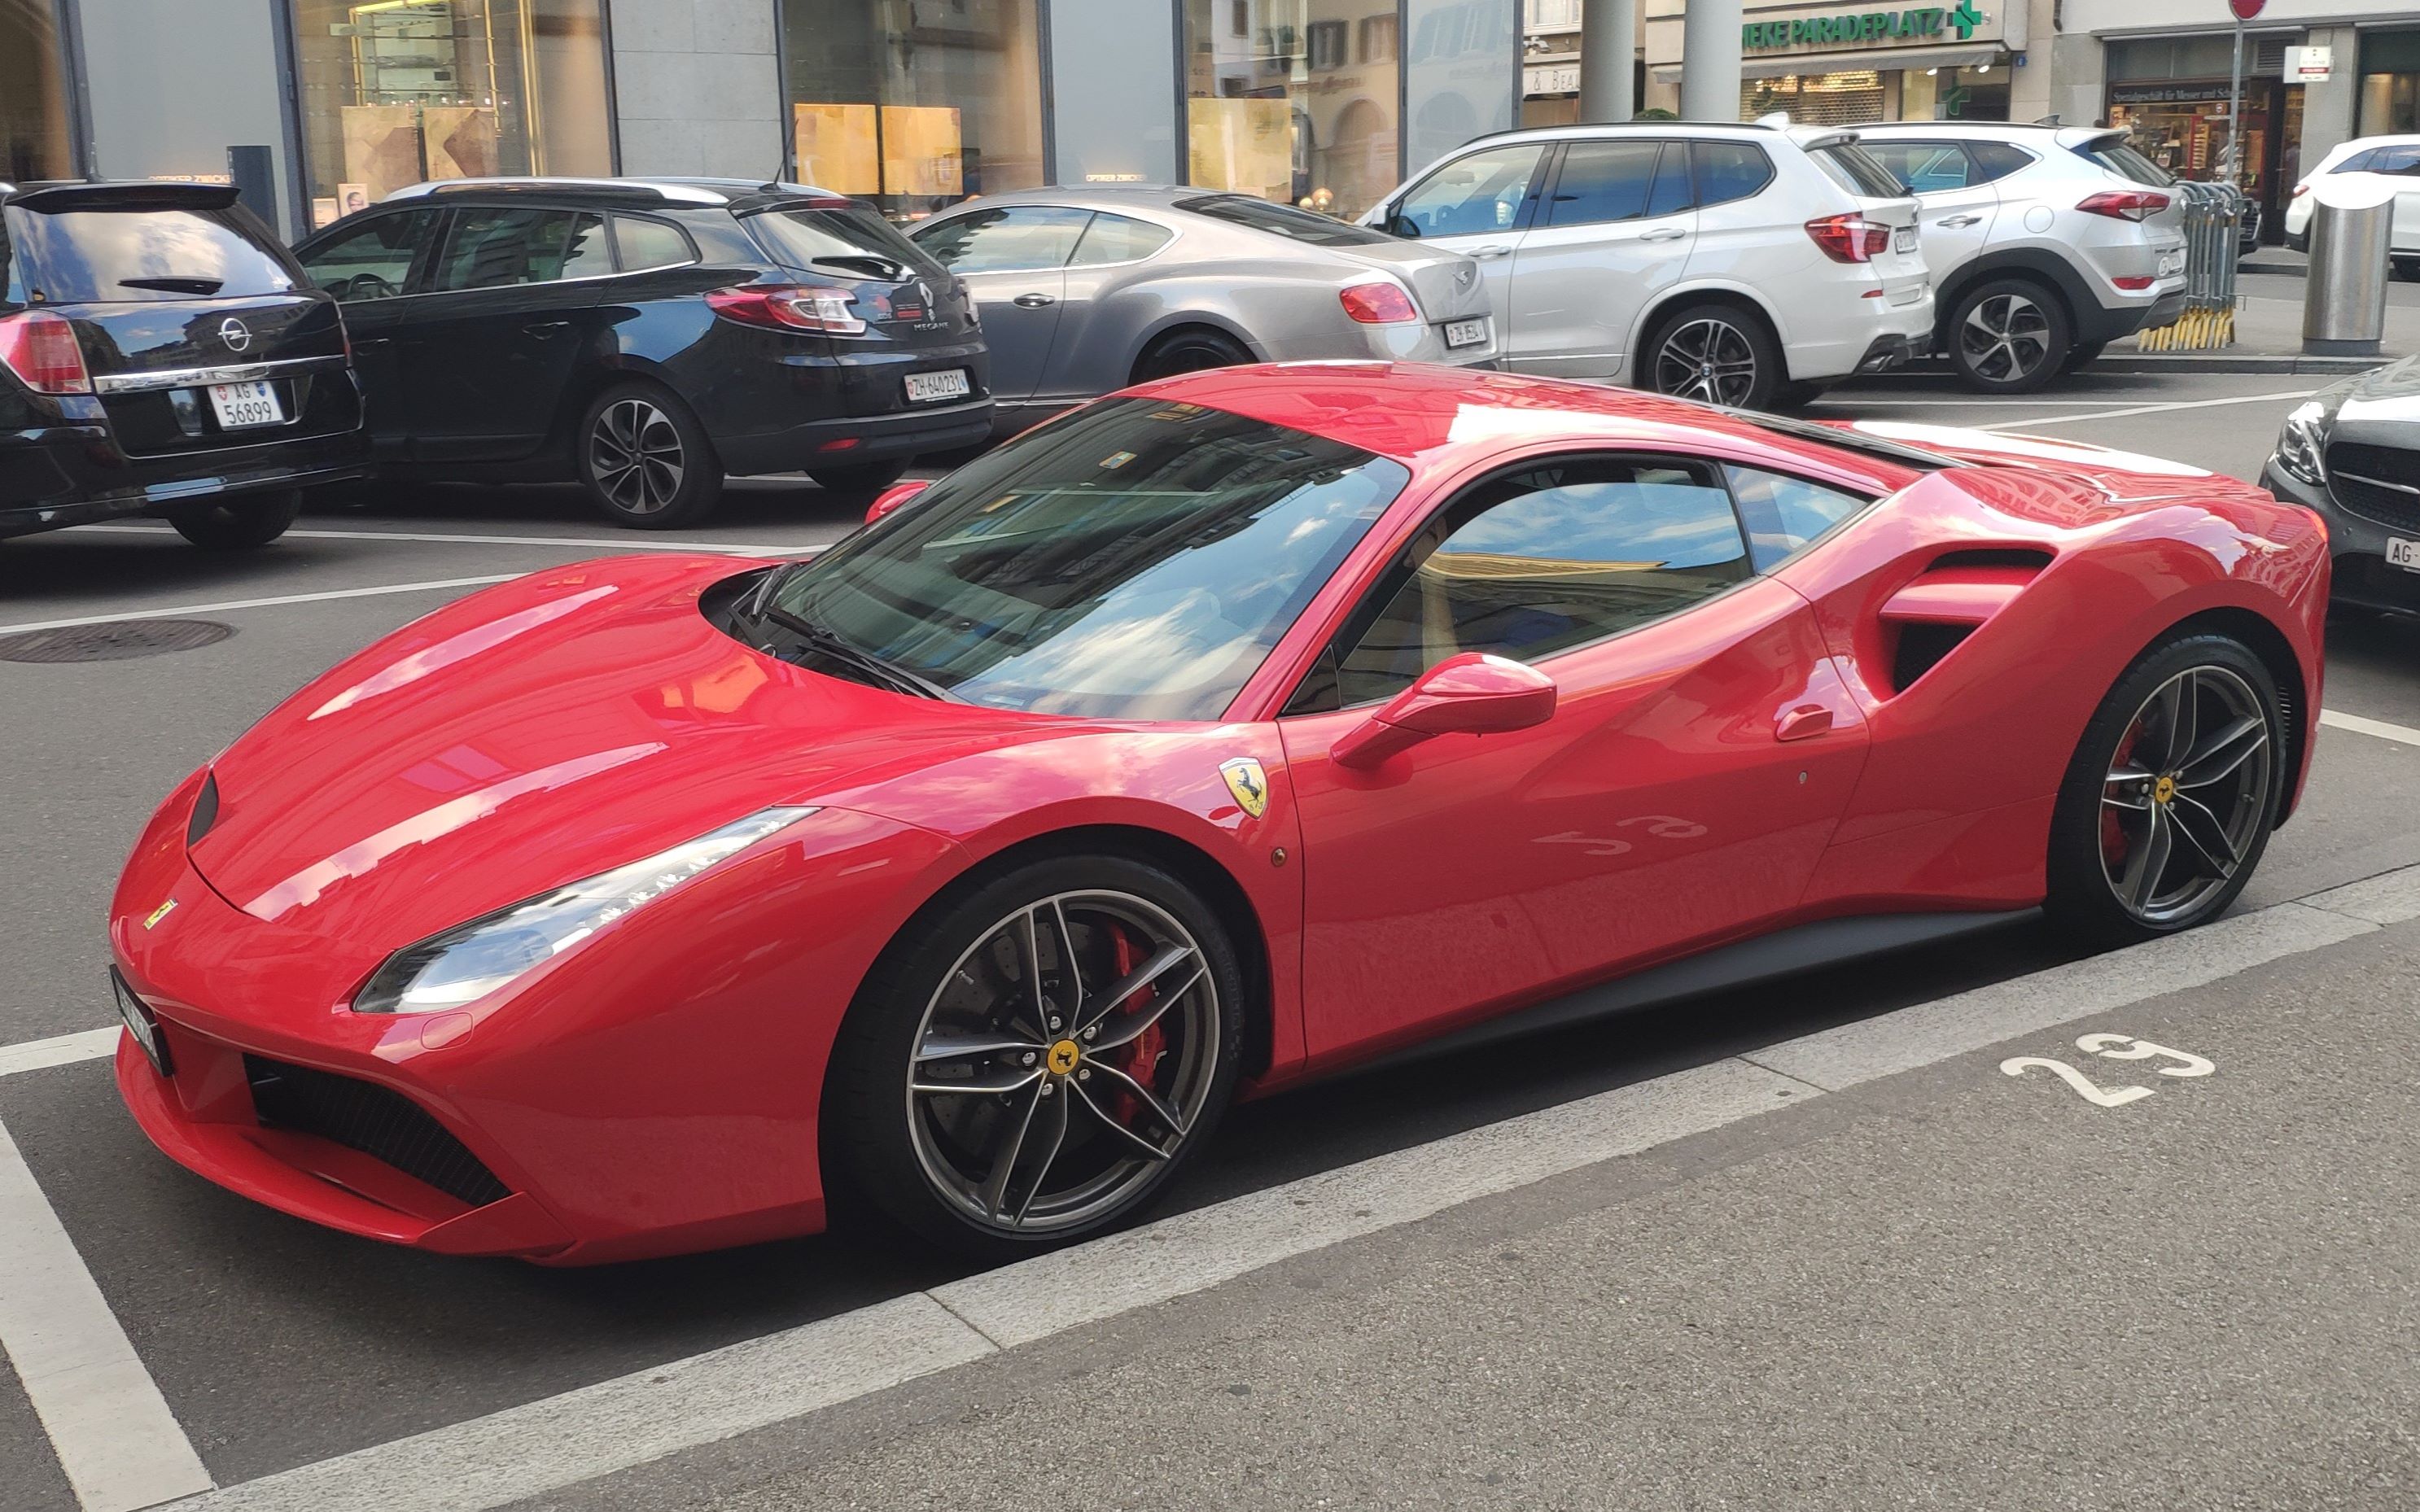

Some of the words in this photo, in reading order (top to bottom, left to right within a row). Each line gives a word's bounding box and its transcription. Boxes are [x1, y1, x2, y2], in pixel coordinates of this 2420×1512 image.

[1791, 7, 1945, 44] PARADEPLATZ
[234, 384, 251, 400] AG
[223, 401, 272, 424] 56899
[2000, 1032, 2216, 1108] 29
